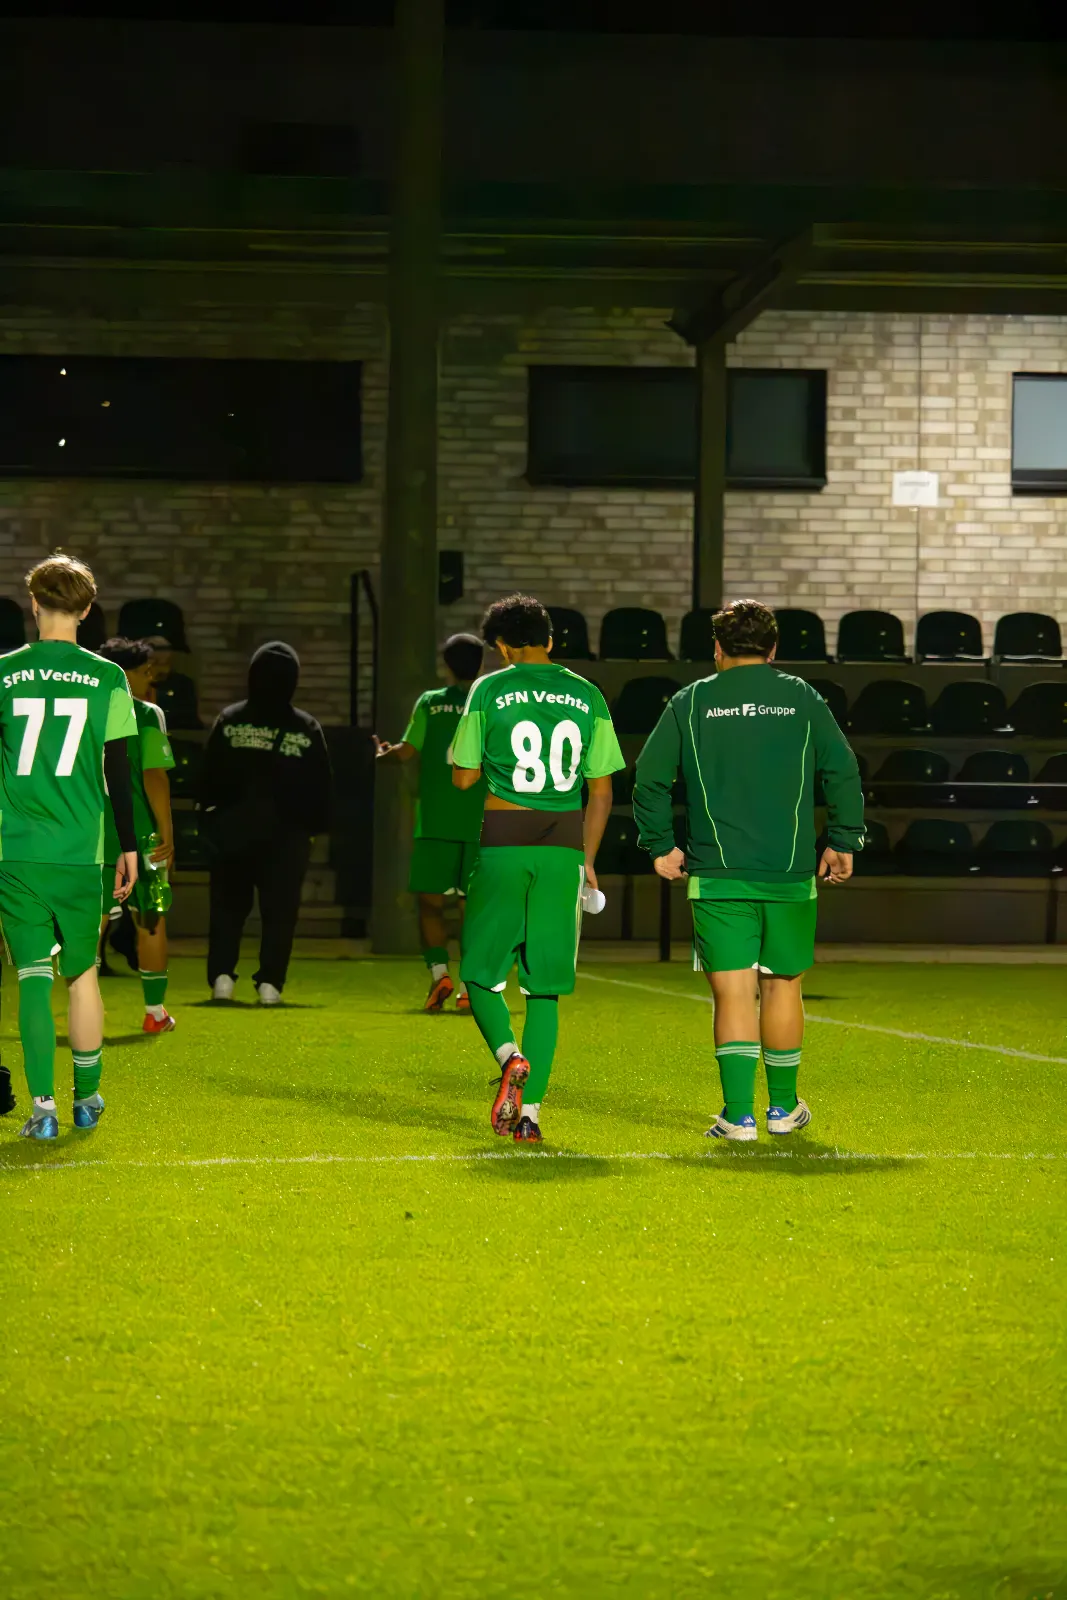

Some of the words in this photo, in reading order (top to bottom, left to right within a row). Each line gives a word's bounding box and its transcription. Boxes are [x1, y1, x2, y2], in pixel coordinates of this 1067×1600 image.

[3, 669, 35, 688] SFN
[39, 669, 100, 687] Vechta
[496, 690, 529, 710] SFN
[532, 690, 590, 714] Vechta
[706, 706, 740, 718] Albert
[757, 704, 796, 716] Gruppe
[12, 698, 88, 776] 77
[510, 719, 583, 793] 80
